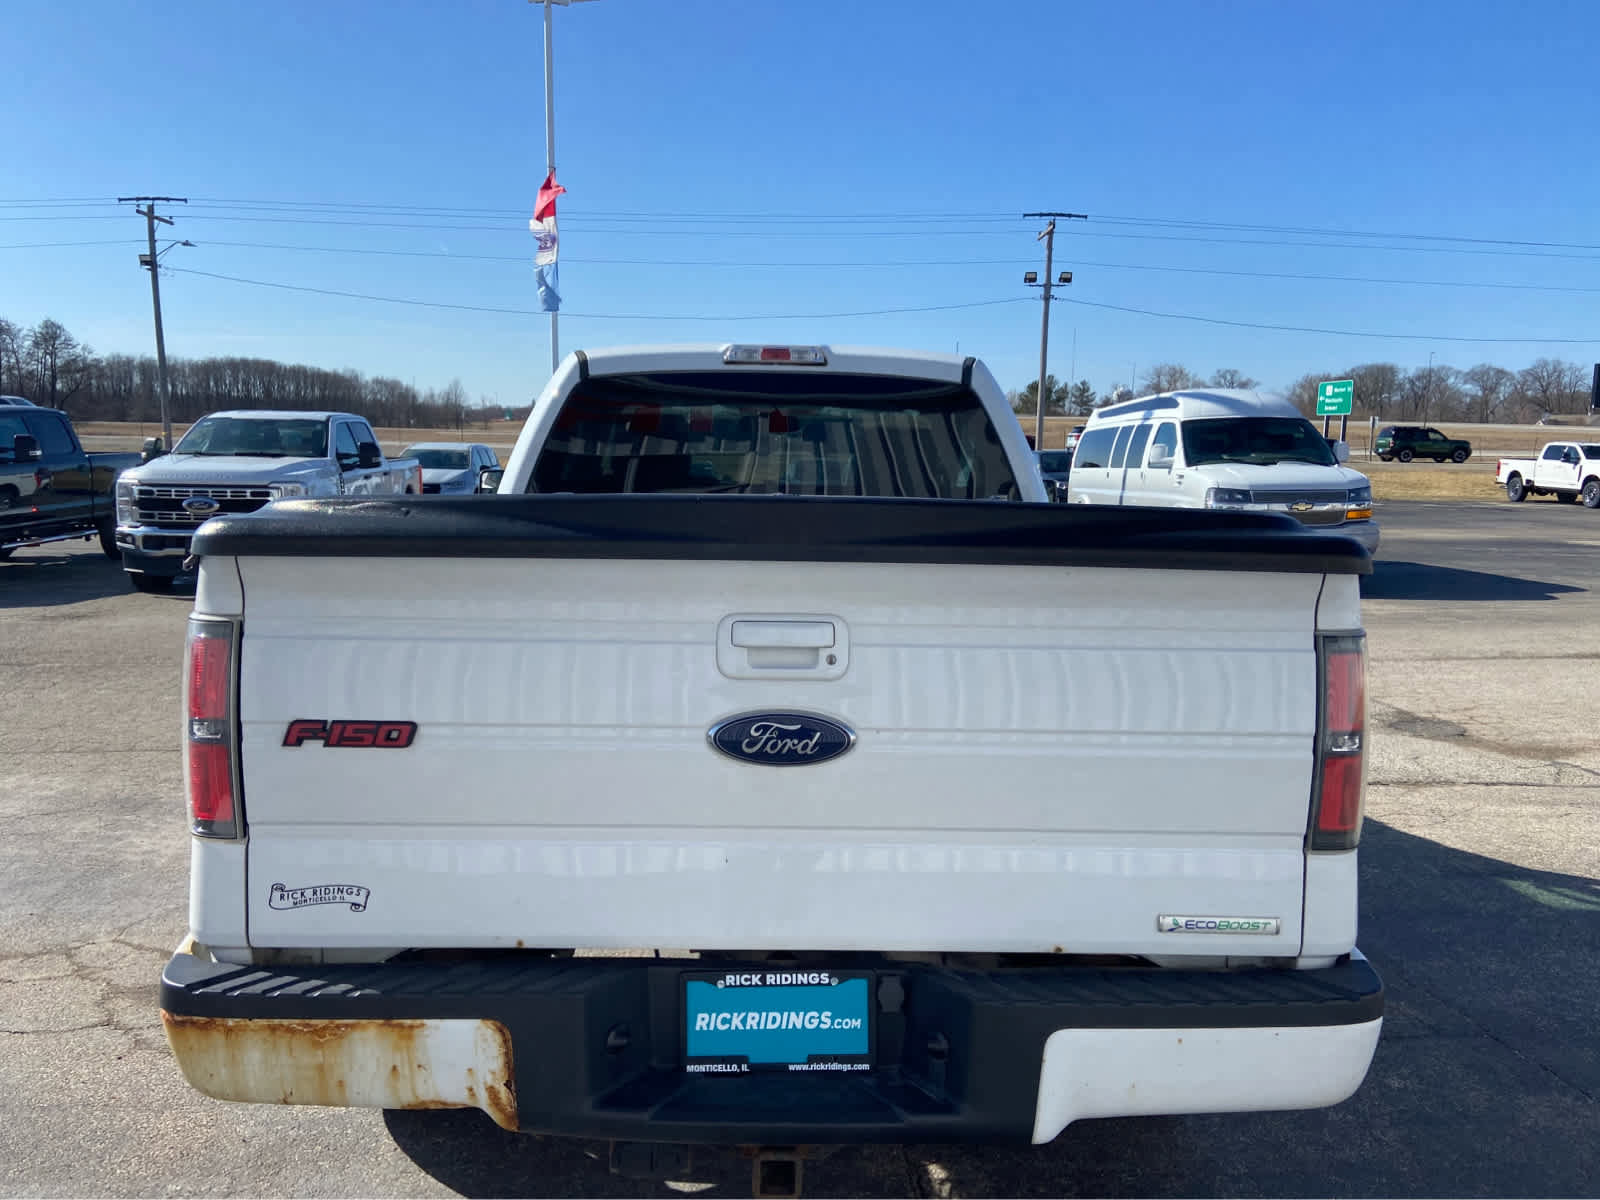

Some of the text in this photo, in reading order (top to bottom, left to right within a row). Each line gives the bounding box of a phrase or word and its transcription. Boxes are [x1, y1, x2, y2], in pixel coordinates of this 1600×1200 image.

[281, 719, 418, 748] F-150
[741, 721, 821, 755] Ford
[279, 887, 361, 901] RICK RIDINGS
[292, 895, 337, 905] MONTICELLO
[1184, 919, 1272, 931] ECOBOOST
[724, 972, 830, 986] RICK RIDINGS
[695, 1011, 862, 1031] RICKRIDINGS.COM
[686, 1063, 750, 1073] MONTICELLO, IL
[788, 1062, 870, 1072] www.rickridings.com
